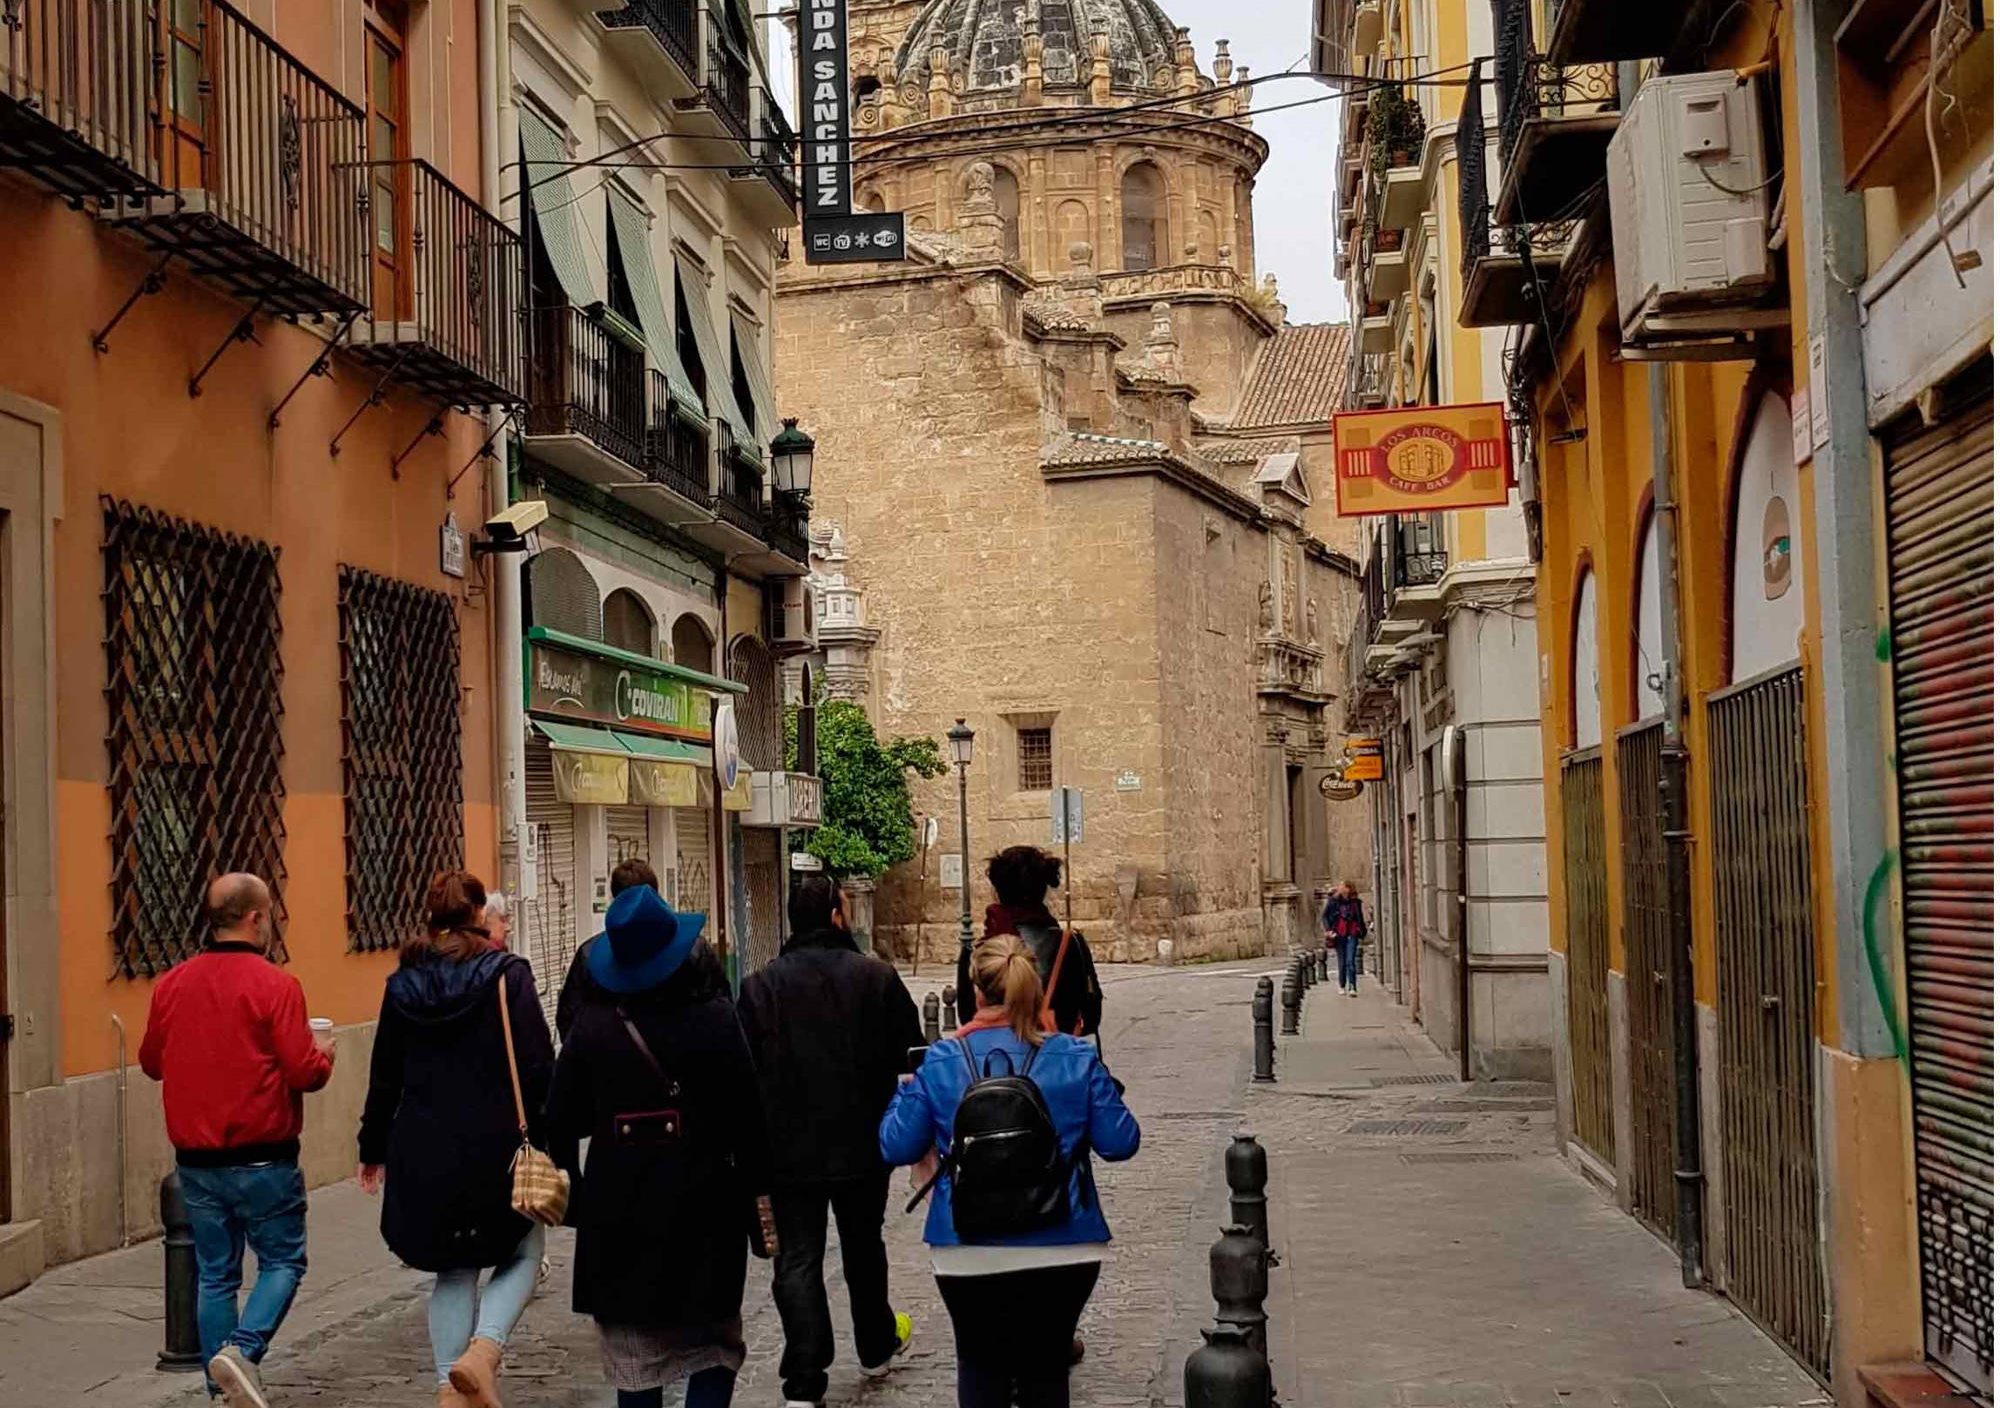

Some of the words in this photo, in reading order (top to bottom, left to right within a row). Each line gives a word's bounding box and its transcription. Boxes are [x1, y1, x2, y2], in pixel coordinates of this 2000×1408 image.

[814, 61, 839, 206] SANCHEZ
[1380, 433, 1406, 452] LOS
[1412, 427, 1458, 447] ARCOS
[1427, 475, 1451, 490] BAR
